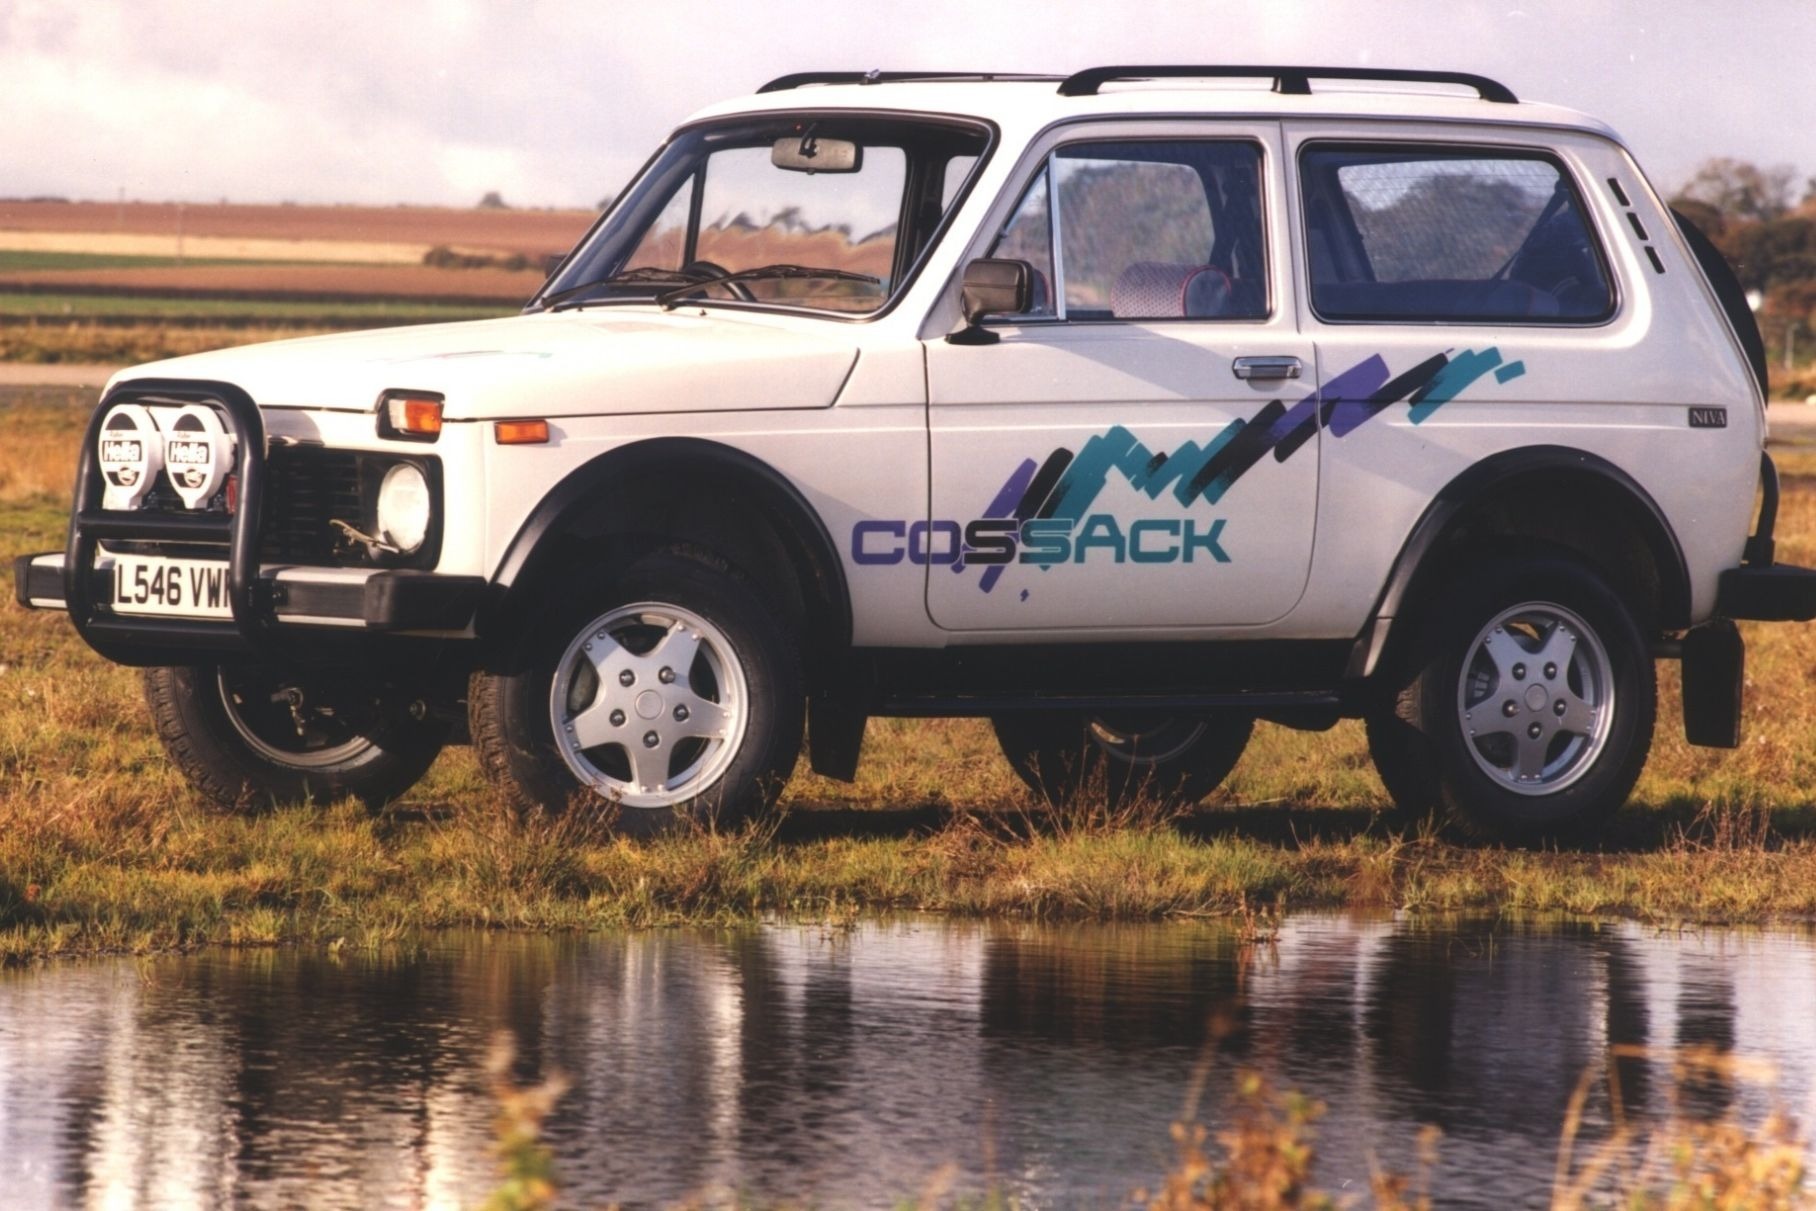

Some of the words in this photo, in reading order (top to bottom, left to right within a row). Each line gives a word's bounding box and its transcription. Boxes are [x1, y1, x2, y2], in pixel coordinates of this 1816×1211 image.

[1692, 409, 1725, 425] NIVA
[103, 441, 141, 462] Hella
[170, 441, 209, 464] Hella
[851, 513, 1232, 566] COSSACK
[117, 564, 182, 606] L546
